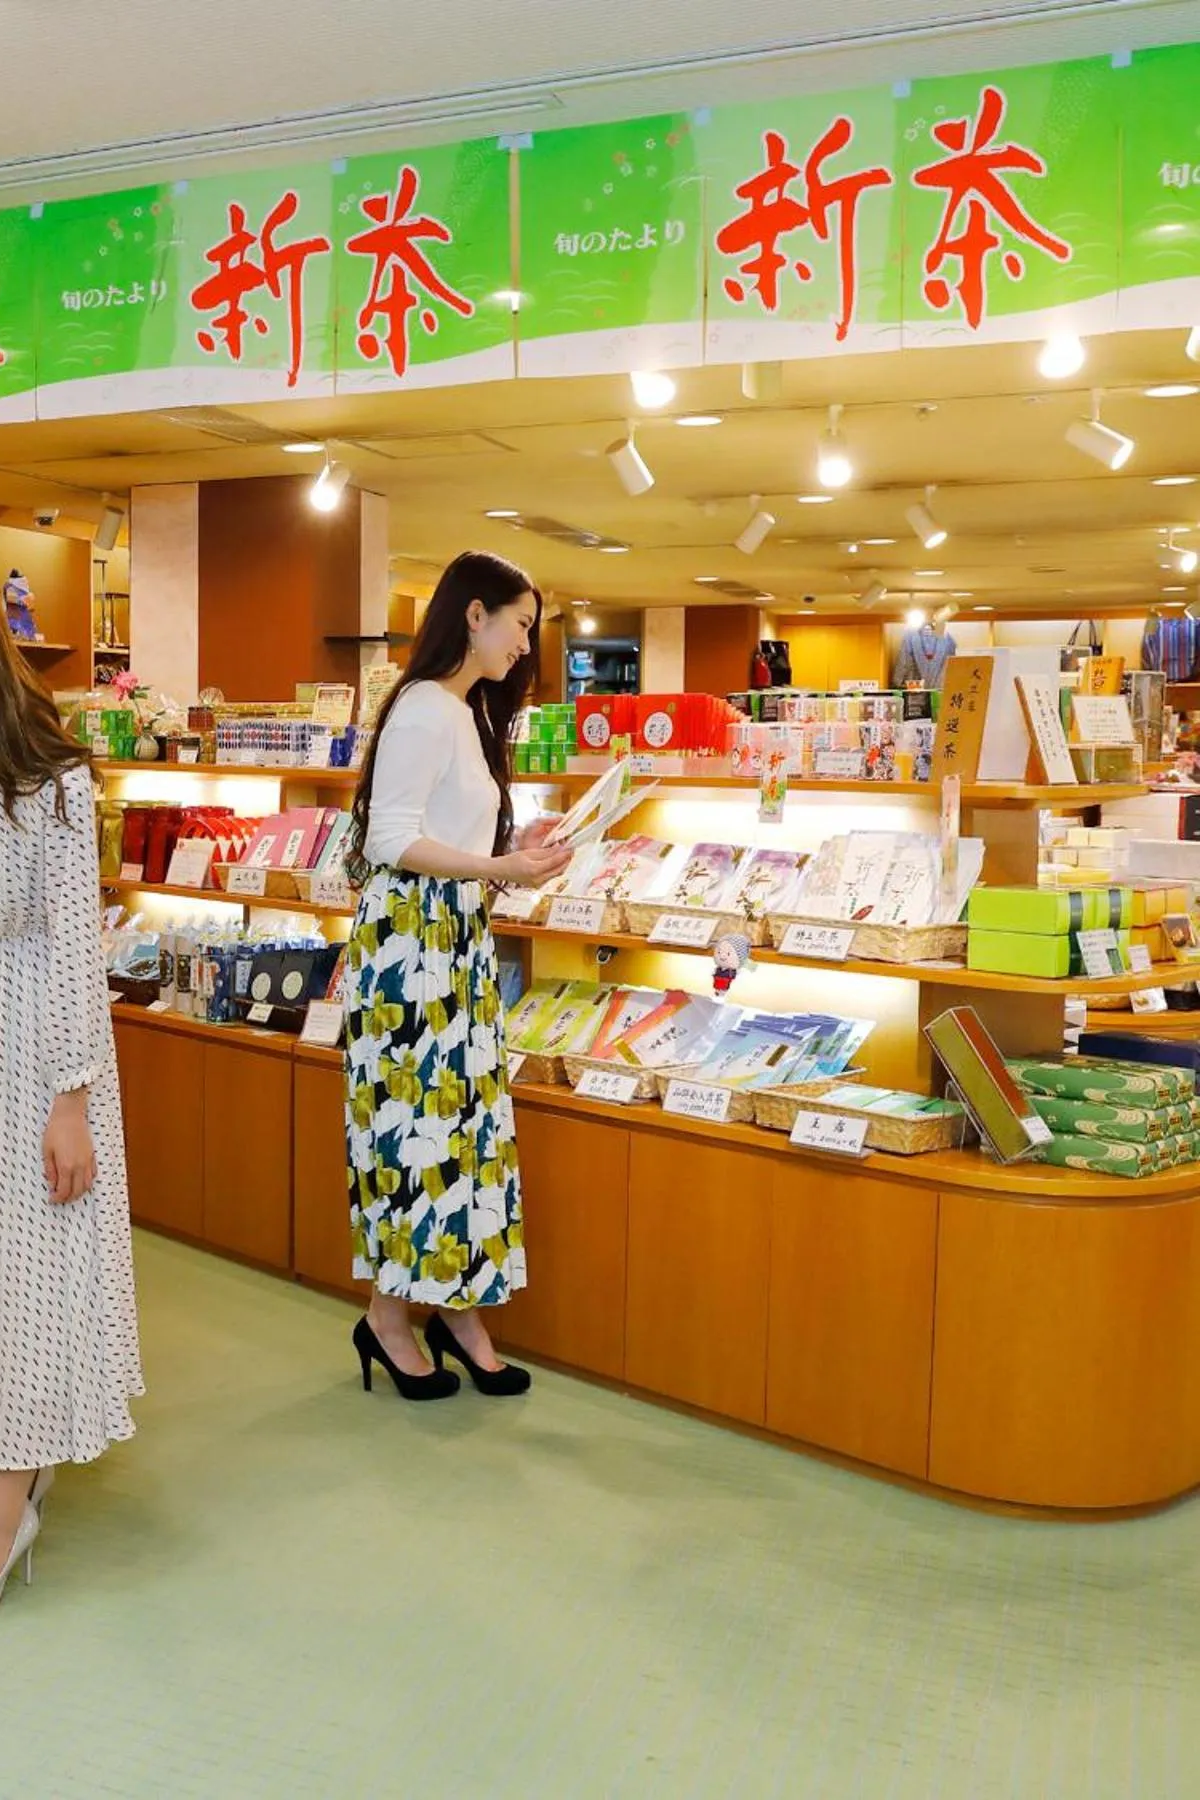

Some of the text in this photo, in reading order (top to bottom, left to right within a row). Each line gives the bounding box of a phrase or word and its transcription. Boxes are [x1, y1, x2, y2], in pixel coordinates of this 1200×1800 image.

[191, 165, 474, 388] 新茶
[553, 219, 686, 256] 旬のたより
[715, 85, 1071, 342] 新茶
[61, 281, 168, 311] 旬のたより
